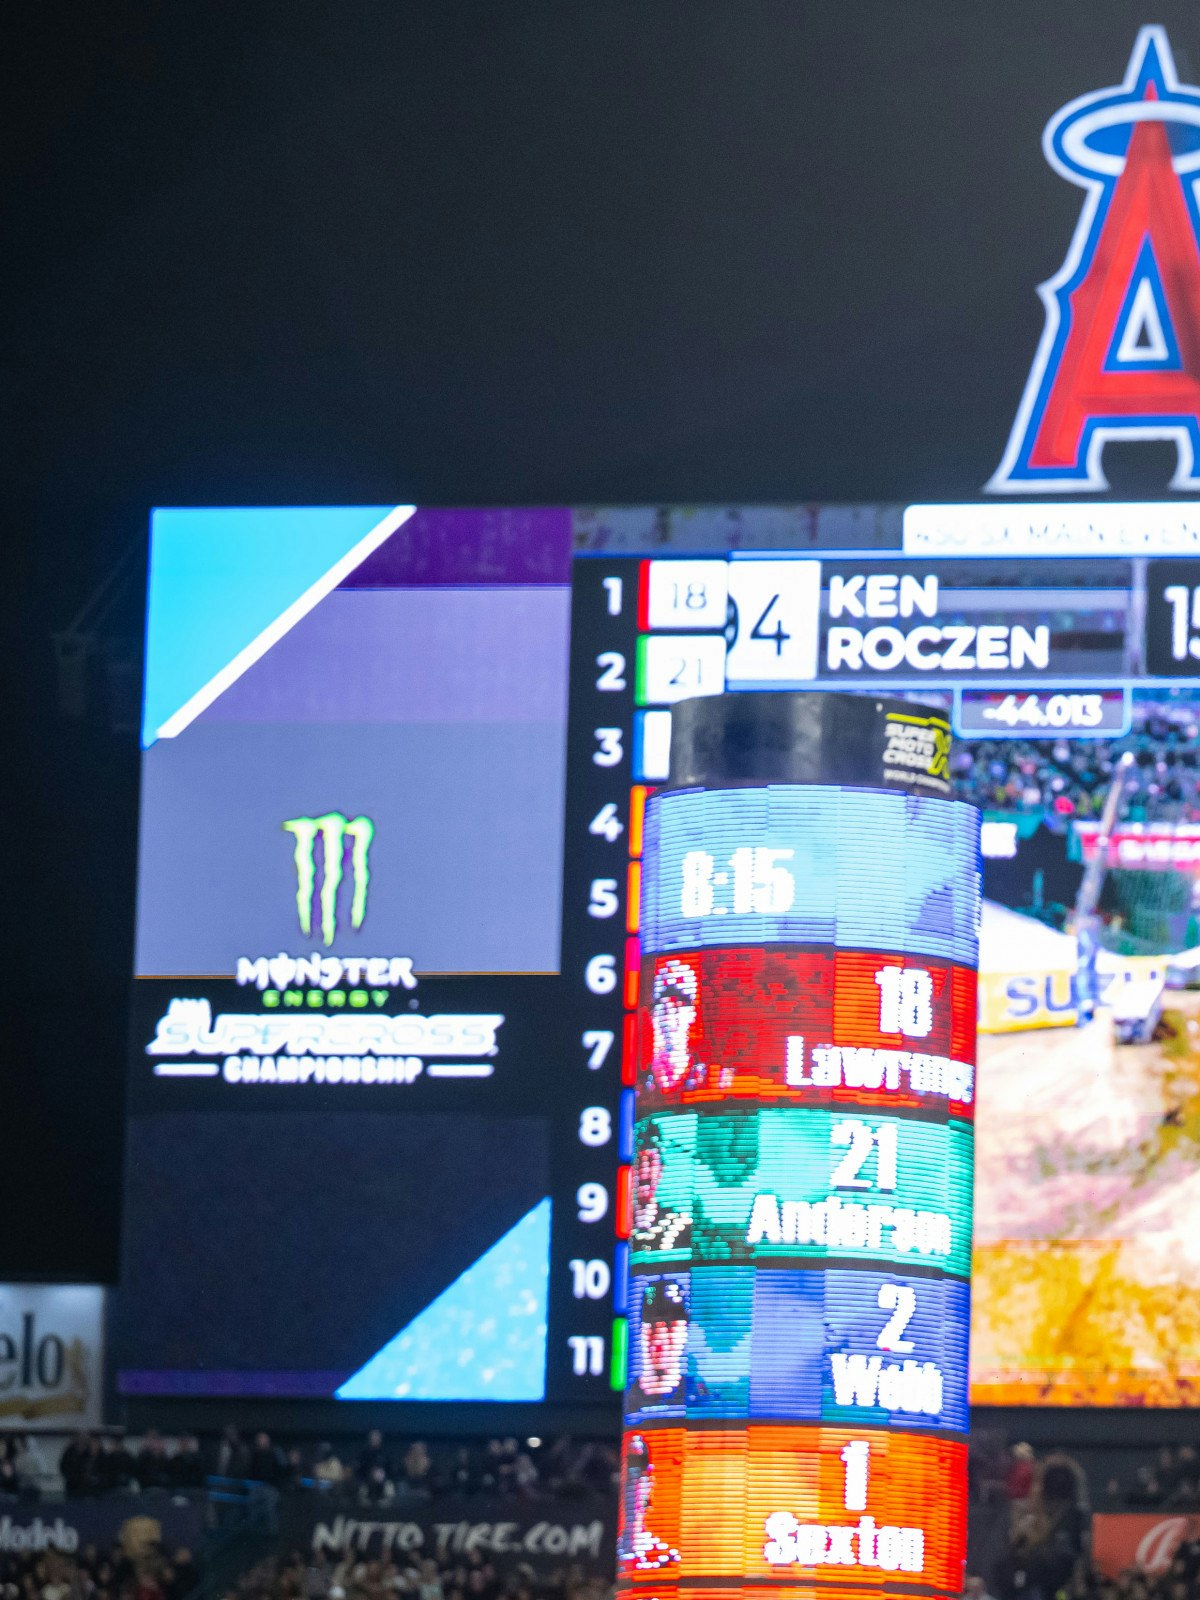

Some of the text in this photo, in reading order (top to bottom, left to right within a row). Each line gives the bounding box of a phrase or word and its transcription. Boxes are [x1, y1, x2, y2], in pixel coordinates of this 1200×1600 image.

[602, 576, 623, 616] 1
[673, 582, 708, 609] 18
[829, 575, 938, 618] KEN
[827, 625, 1049, 670] ROCZEN
[596, 651, 626, 691] 2
[669, 657, 702, 684] 21
[592, 727, 624, 767] 3
[588, 802, 624, 842] 4
[587, 878, 619, 919] 5
[681, 847, 795, 917] 8:15
[237, 952, 418, 989] MONSTER
[585, 954, 618, 995] 6
[263, 989, 390, 1008] ENERGY
[875, 966, 933, 1037] 18
[148, 1013, 504, 1056] SUPERCROSS
[582, 1030, 614, 1070] 7
[222, 1056, 423, 1083] CHAMPIONSHIP
[578, 1106, 612, 1146] 8
[829, 1119, 898, 1190] 21
[576, 1182, 609, 1223] 9
[569, 1258, 611, 1300] 10
[877, 1284, 917, 1353] 2
[567, 1336, 605, 1377] 11
[840, 1441, 870, 1511] 1
[311, 1516, 425, 1552] NITTO
